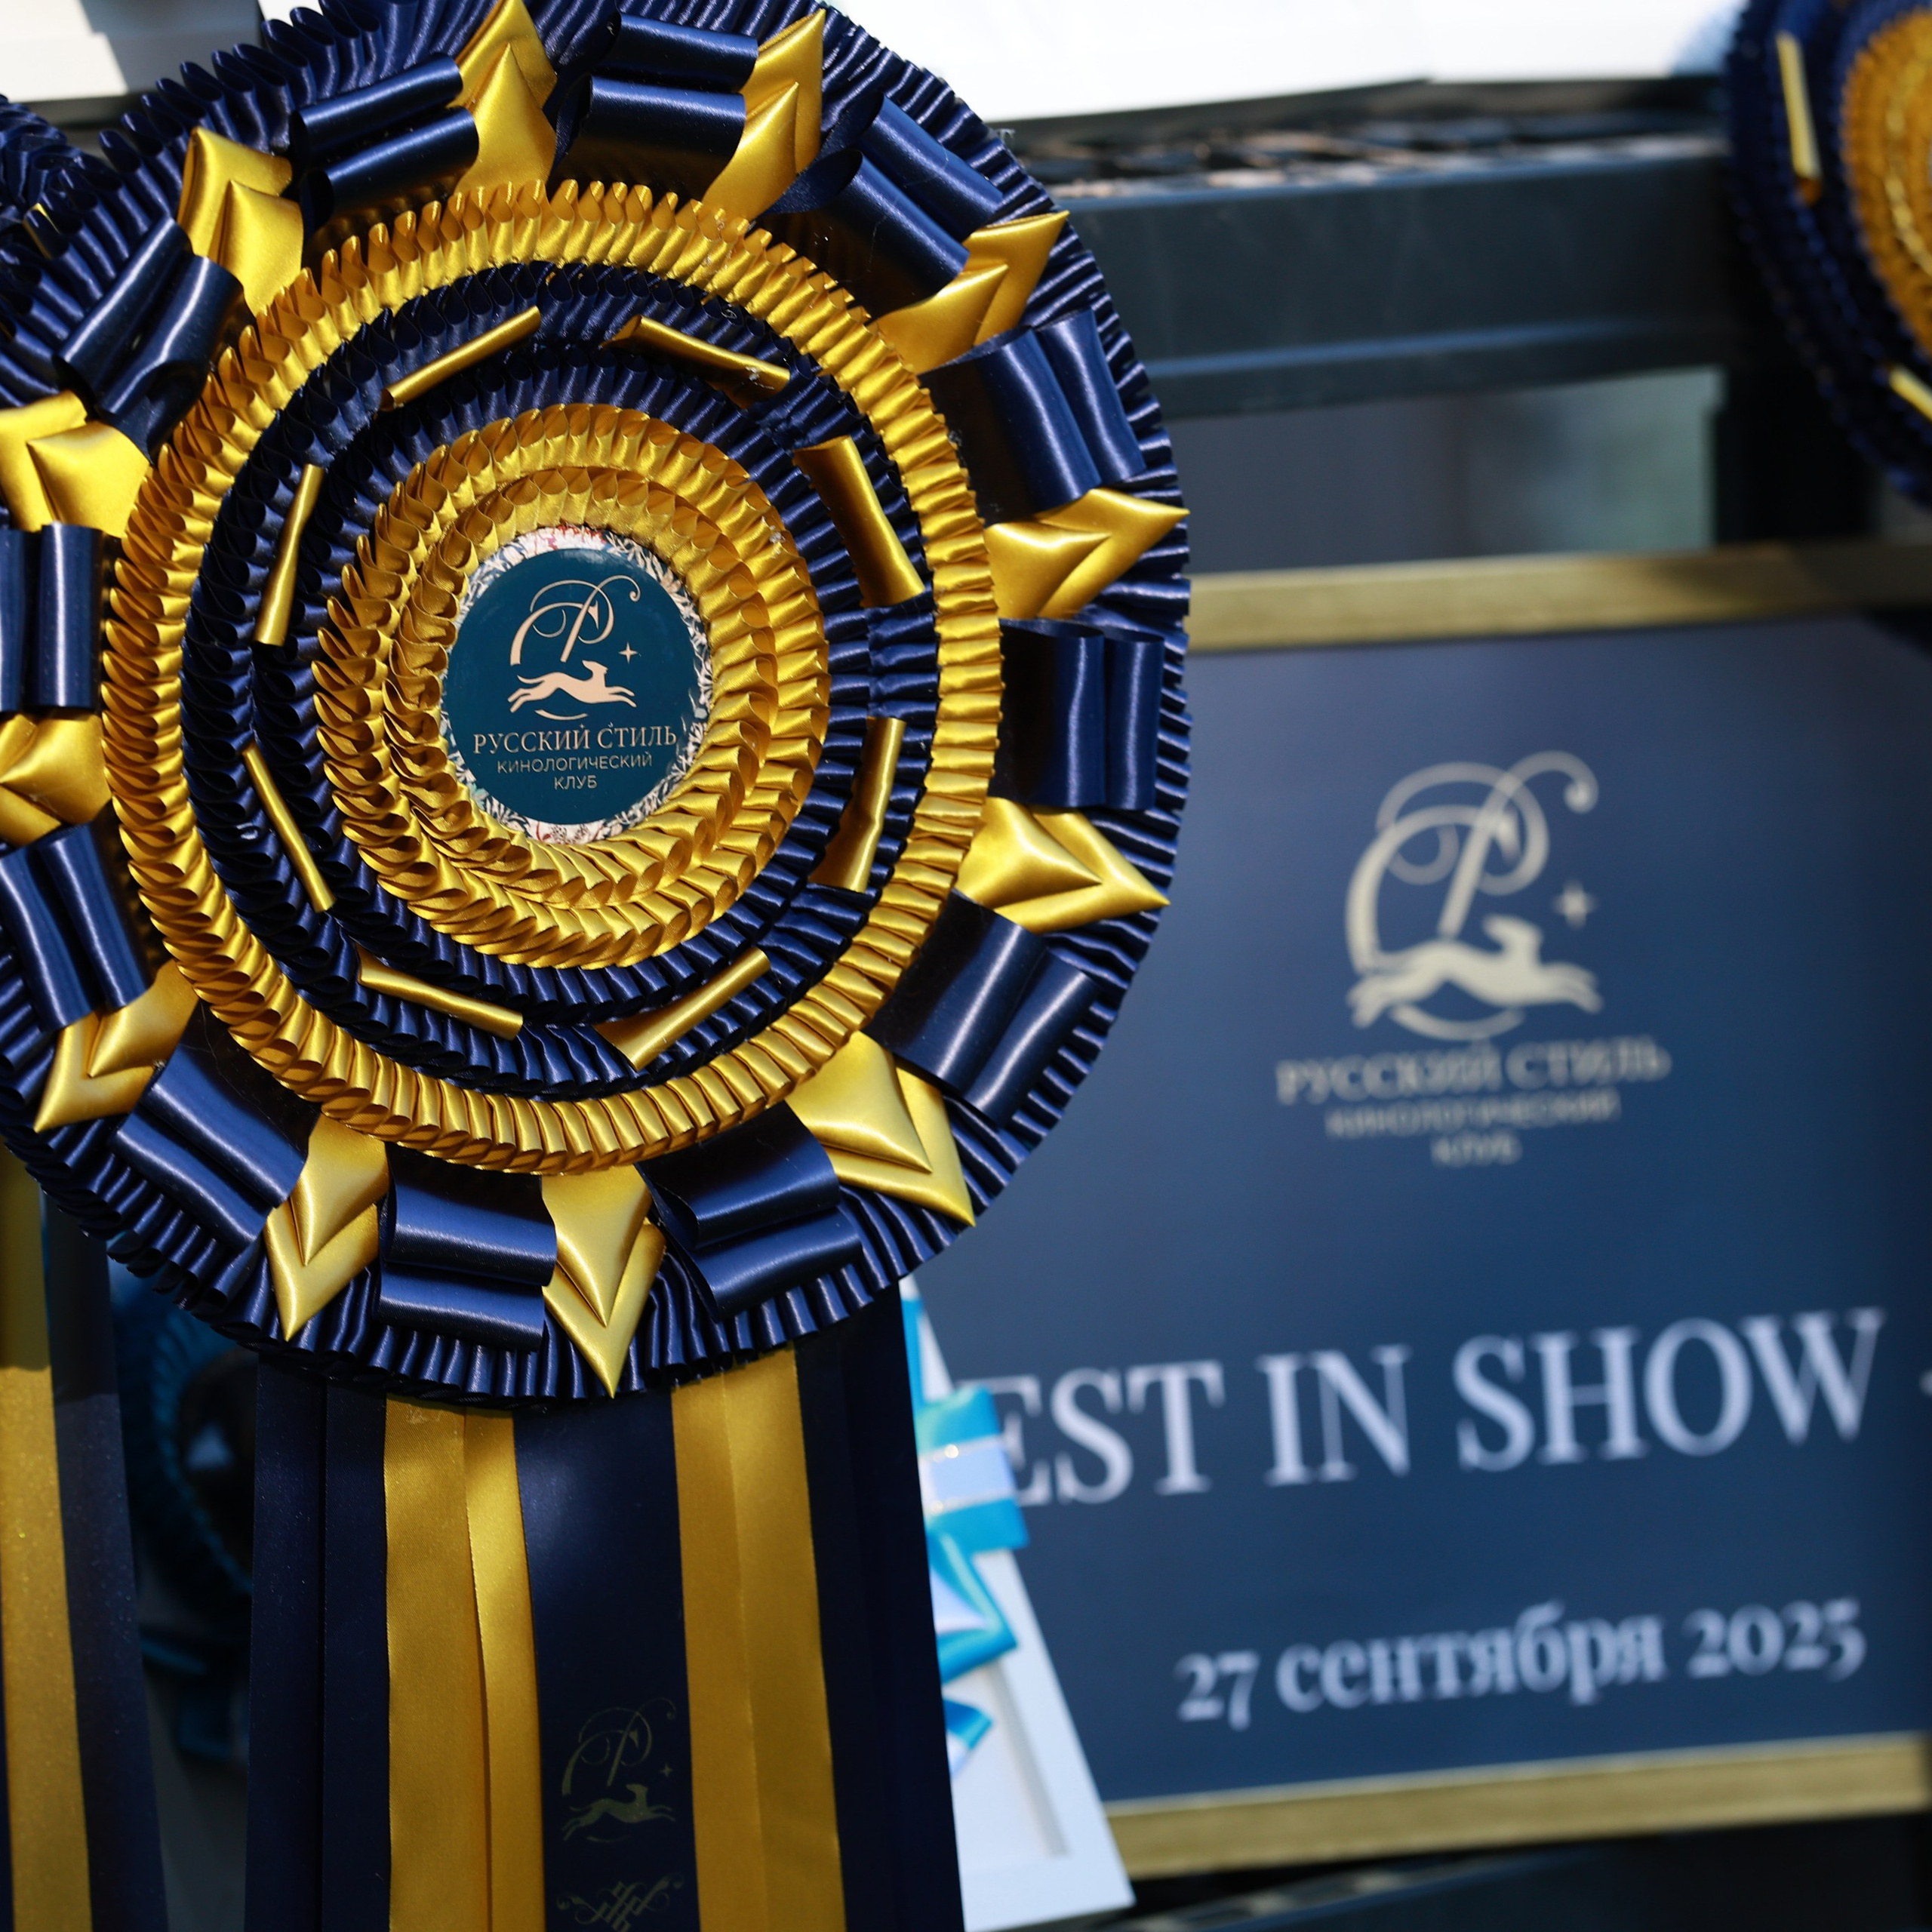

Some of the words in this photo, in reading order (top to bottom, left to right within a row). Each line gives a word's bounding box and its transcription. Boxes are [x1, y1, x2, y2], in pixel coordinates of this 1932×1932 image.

[473, 723, 591, 754] РУССКИЙ
[597, 722, 677, 750] СТИЛЬ
[497, 751, 652, 774] КИНОЛОГИЧЕСКИЙ
[553, 775, 598, 790] КЛУБ
[955, 1358, 1226, 1506] EST
[1255, 1344, 1411, 1487] IN
[1451, 1307, 1885, 1472] SHOW
[1176, 1651, 1260, 1730] 27
[1274, 1599, 1668, 1709] сентября
[1681, 1597, 1867, 1681] 2025
